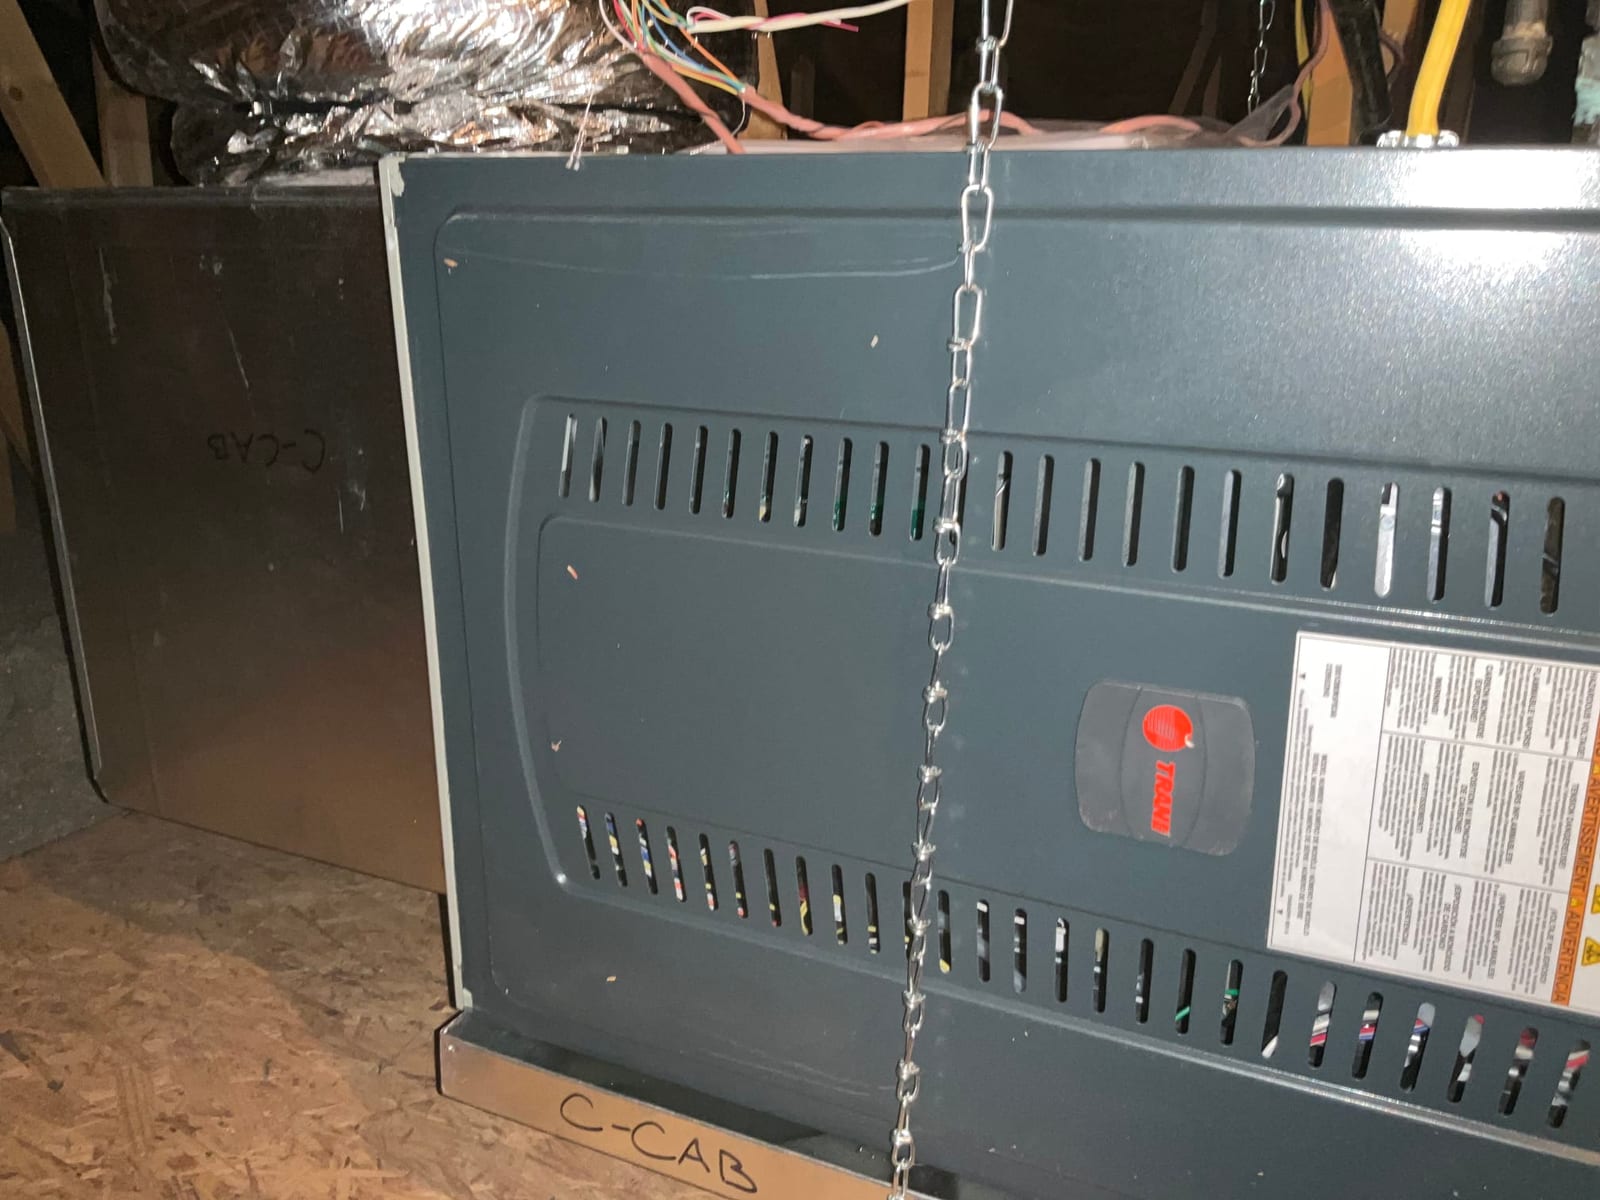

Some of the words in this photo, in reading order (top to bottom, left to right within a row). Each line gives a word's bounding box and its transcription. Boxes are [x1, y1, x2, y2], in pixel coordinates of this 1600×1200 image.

[207, 428, 326, 473] C-CAB
[1482, 665, 1493, 697] CARBON
[1527, 667, 1541, 715] FLAMMABLE
[1468, 762, 1480, 805] EXPOSITION
[1514, 771, 1526, 805] VAPEURS
[1568, 784, 1579, 815] TENSION
[1571, 777, 1600, 892] AVERTISSEMENT
[1554, 910, 1581, 1002] ADVERTENCIA
[560, 1093, 758, 1193] C-CAB
